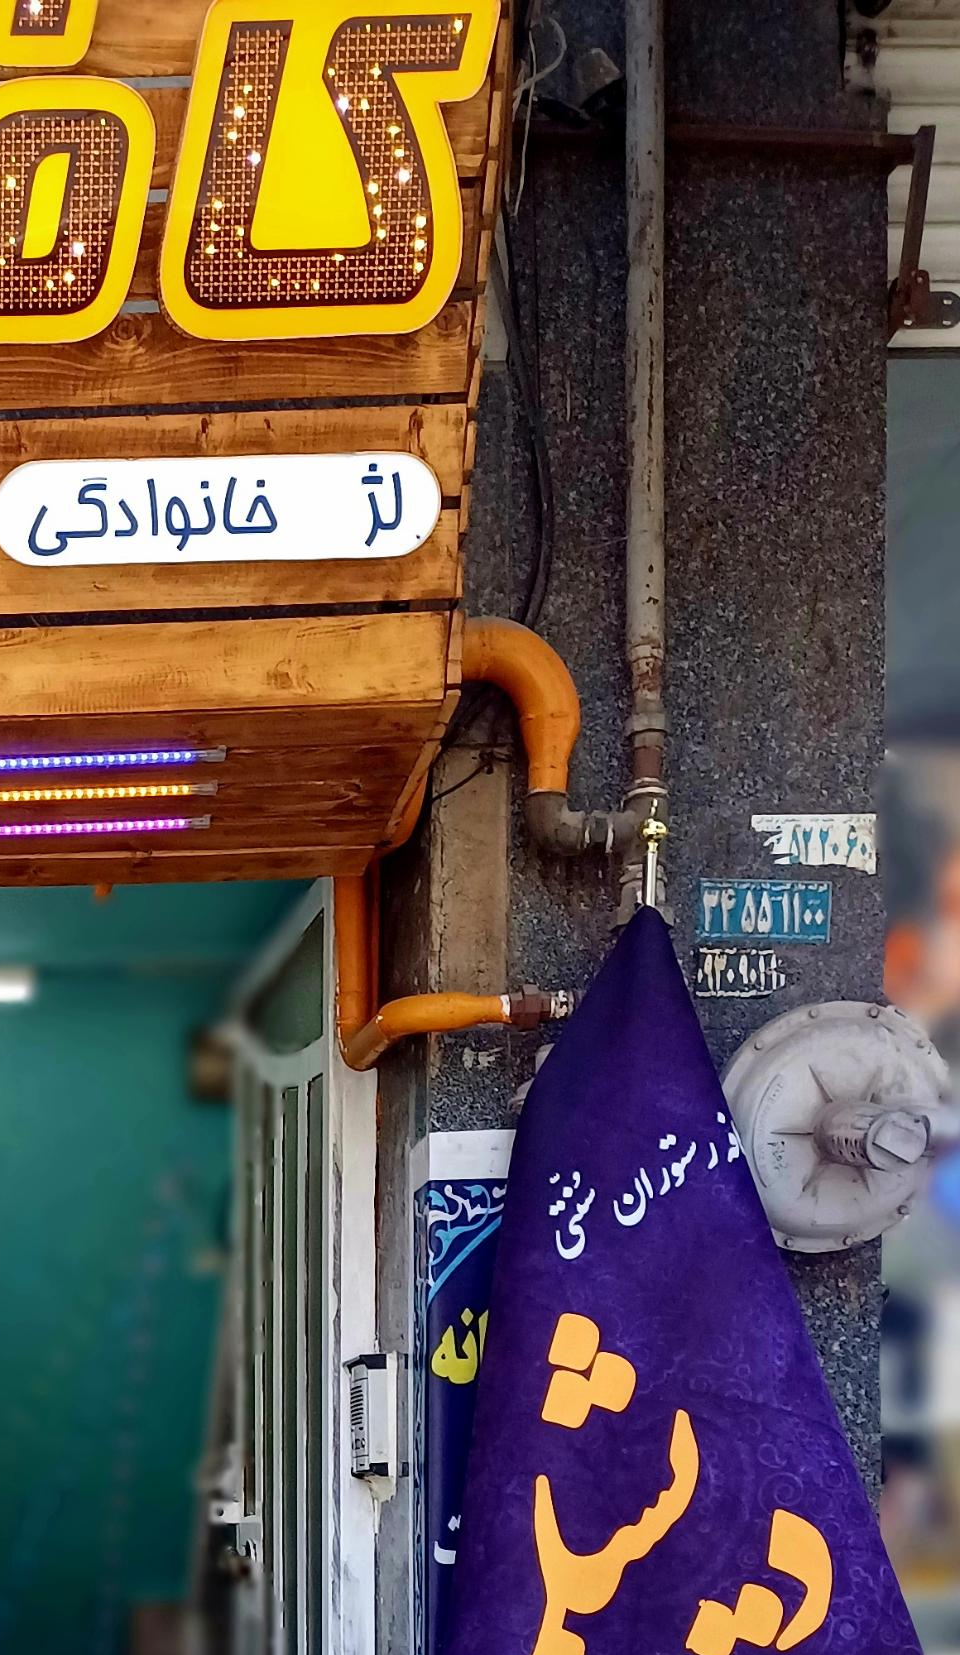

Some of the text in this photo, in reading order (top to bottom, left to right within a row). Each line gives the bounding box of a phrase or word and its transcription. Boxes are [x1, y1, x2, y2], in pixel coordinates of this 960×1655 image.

[28, 462, 404, 557] لژ خانوادگی
[778, 824, 869, 864] ۵۲۲۰۶۰
[613, 1134, 719, 1226] رستوران
